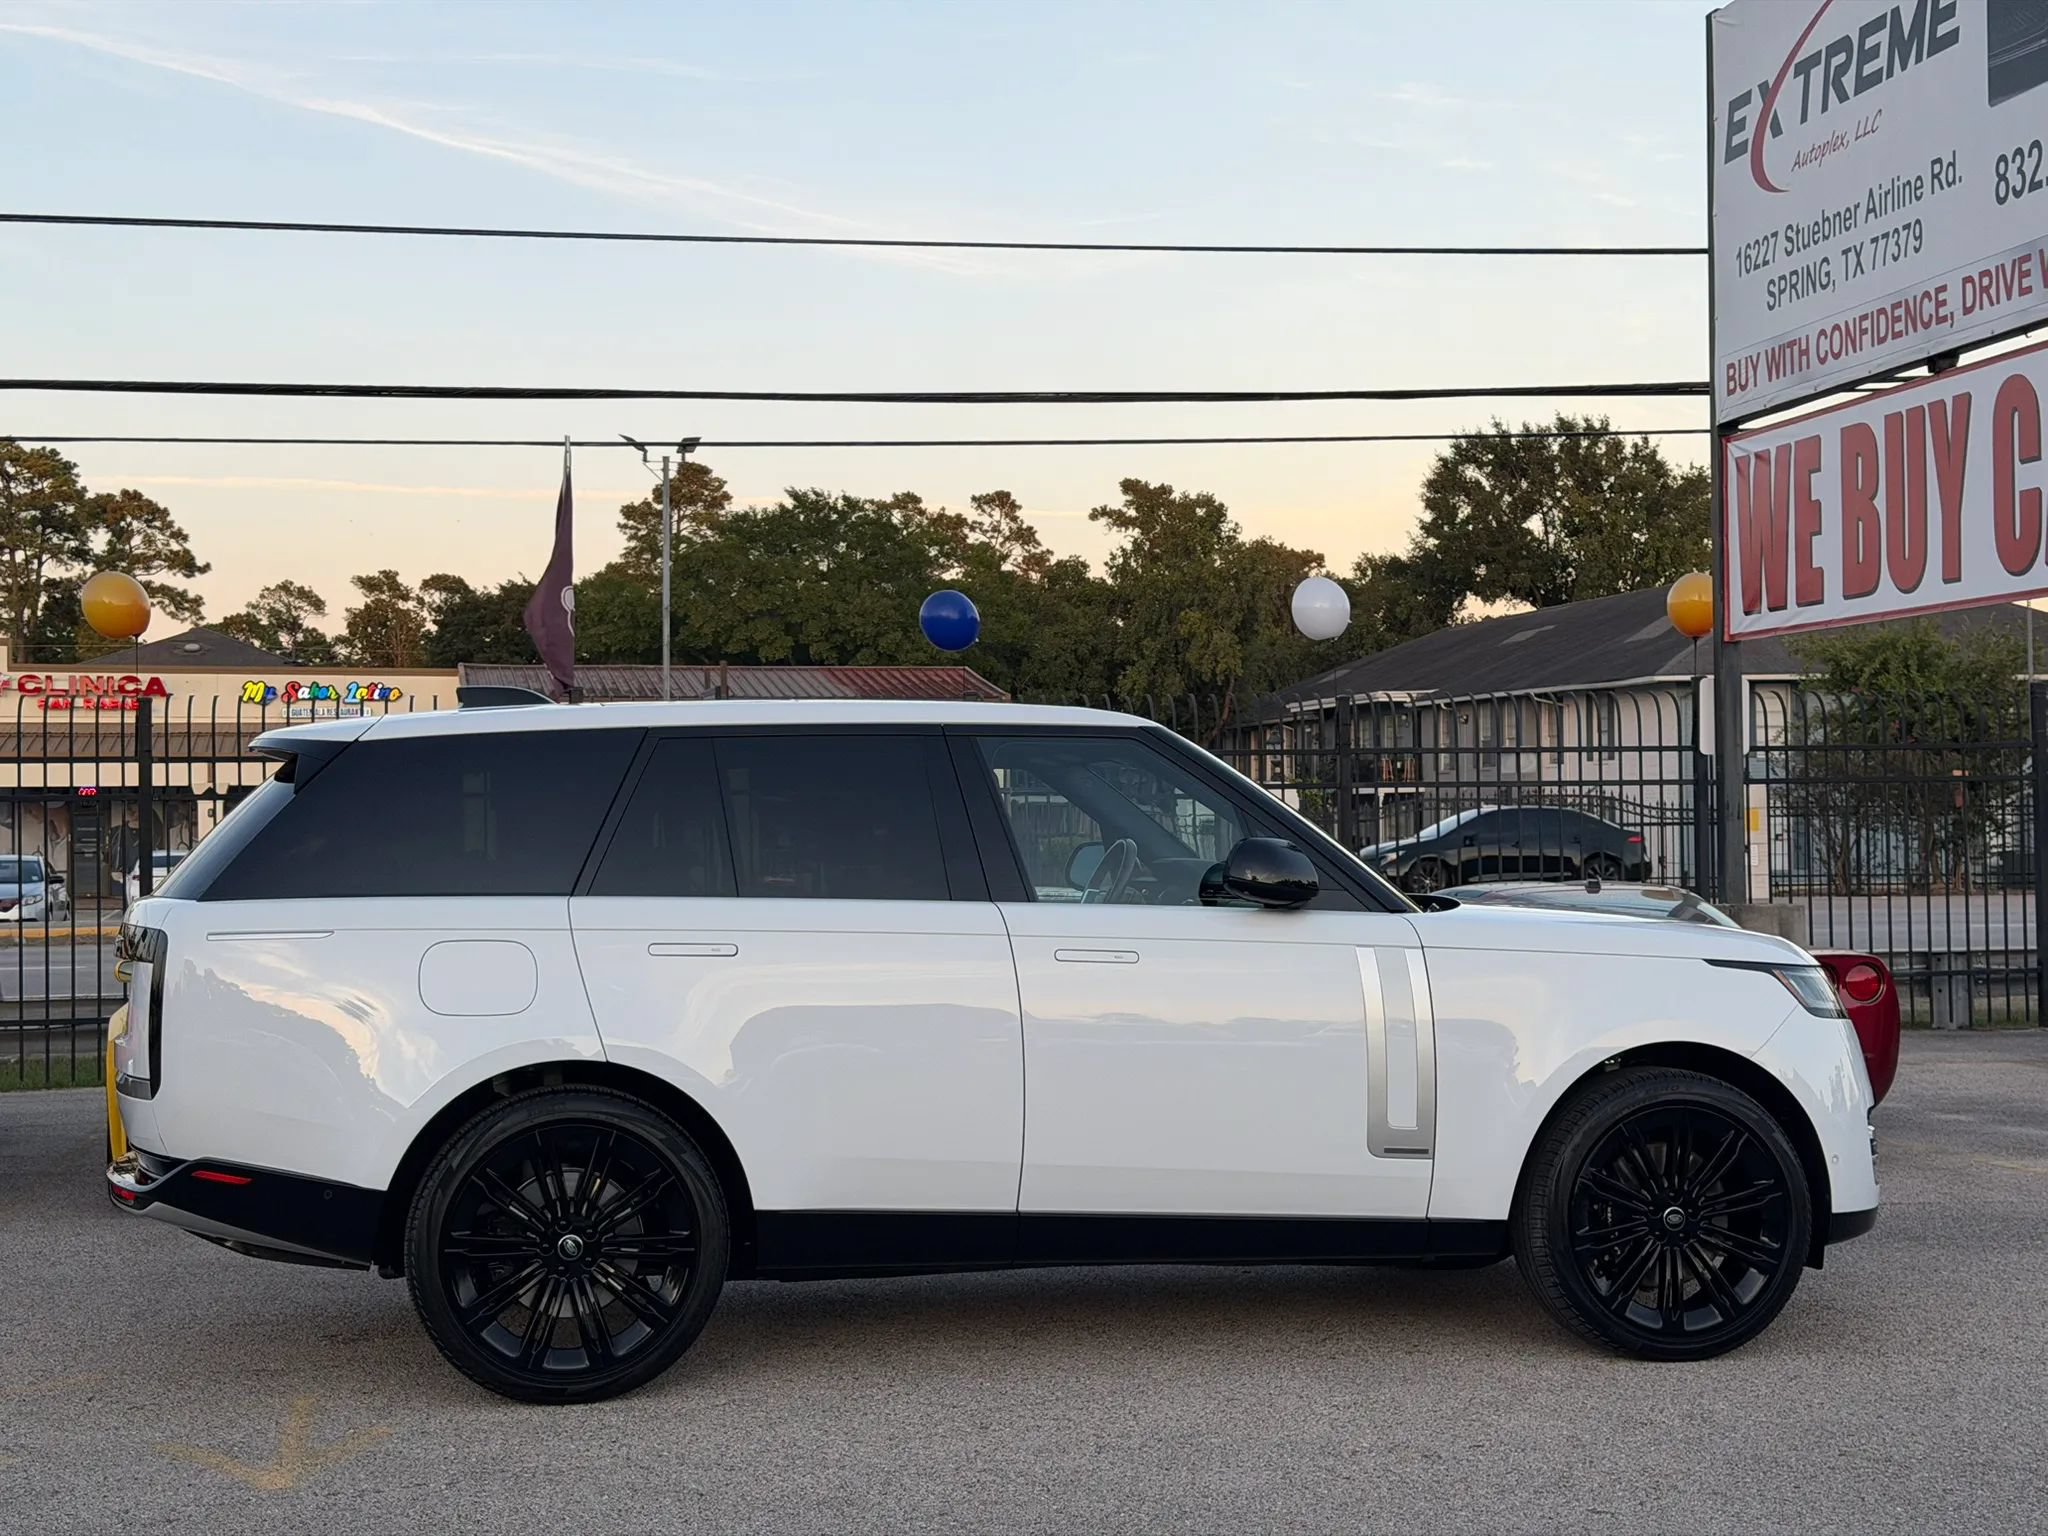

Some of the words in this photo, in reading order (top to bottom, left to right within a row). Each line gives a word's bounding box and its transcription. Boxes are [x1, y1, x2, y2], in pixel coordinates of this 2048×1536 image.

[1724, 0, 1960, 164] EXTREME
[1791, 129, 1850, 172] Autoplex,
[1854, 108, 1883, 141] LLC
[1736, 230, 1779, 278] 16227
[1784, 201, 1860, 257] Stuebner
[1864, 175, 1924, 224] Airline
[1930, 150, 1963, 195] Rd.
[1766, 256, 1836, 312] SPRING,
[1841, 241, 1865, 282] TX
[1870, 218, 1923, 271] 77379
[1726, 352, 1760, 397] BUY
[1765, 334, 1810, 383] WITH
[1815, 283, 1954, 366] CONFIDENCE,
[1961, 253, 2033, 316] DRIVE
[1735, 434, 1824, 616] WE
[1840, 391, 1972, 601] BUY
[1992, 373, 2048, 577] C
[18, 674, 168, 697] CLINICA
[281, 680, 341, 704] Sabor
[343, 681, 402, 704] Latino
